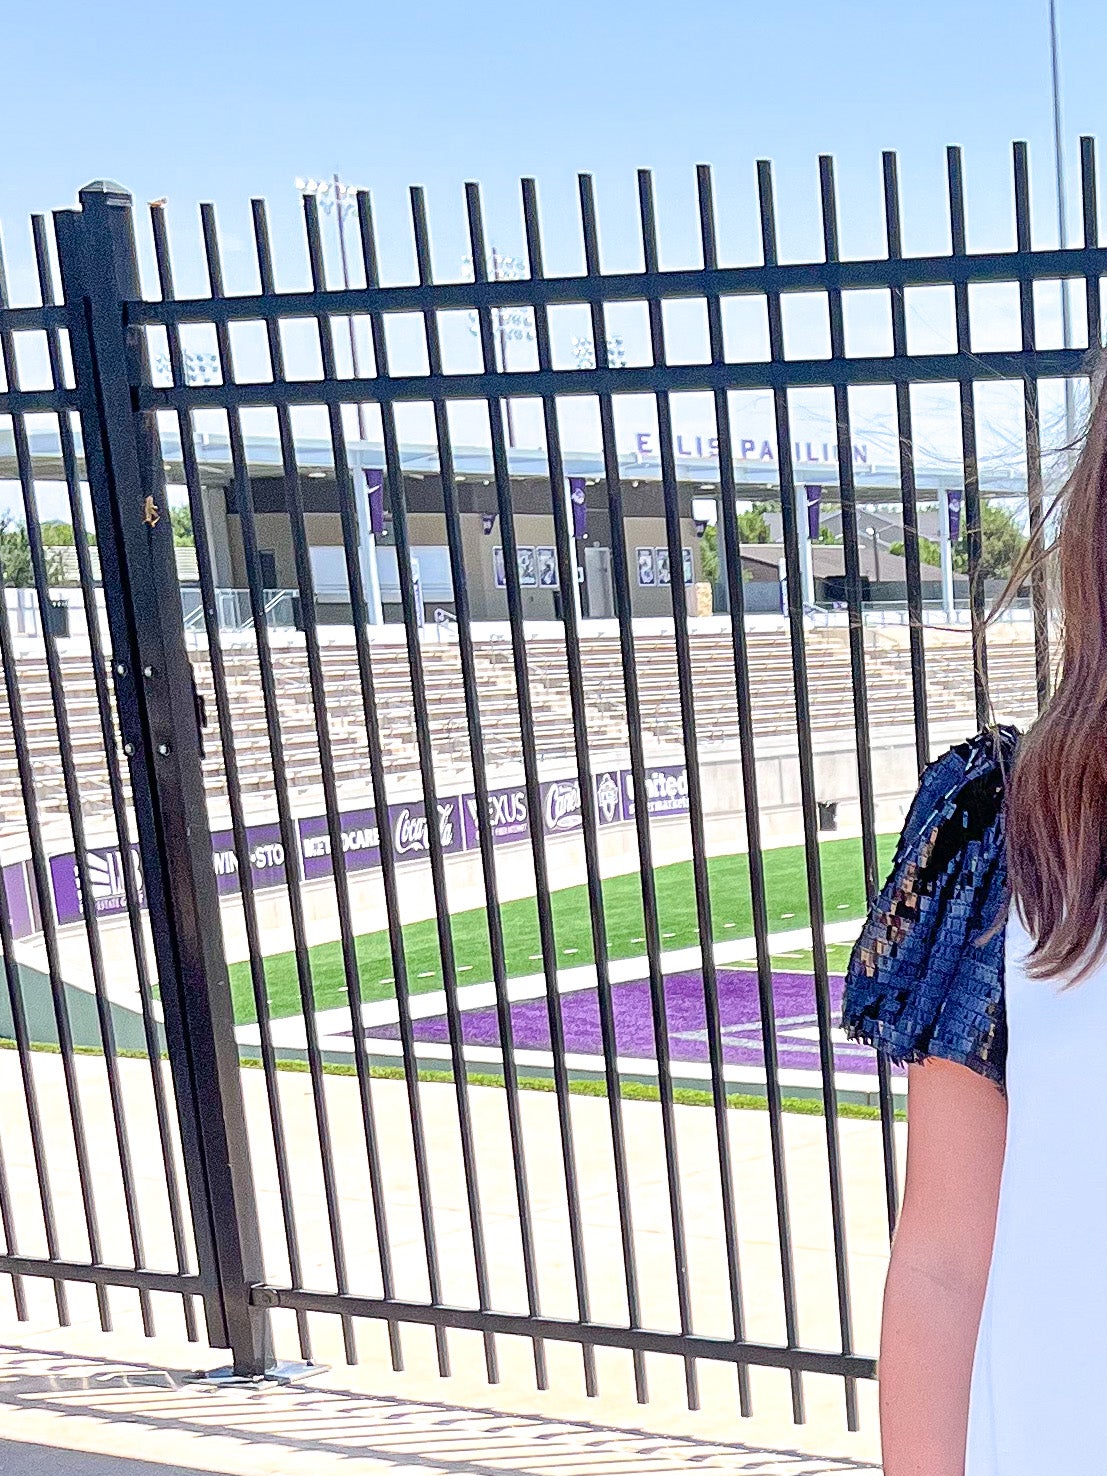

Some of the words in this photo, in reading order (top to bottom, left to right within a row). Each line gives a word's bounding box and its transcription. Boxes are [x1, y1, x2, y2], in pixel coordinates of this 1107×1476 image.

[636, 433, 719, 458] ELIS
[741, 439, 868, 463] PAILIN
[302, 827, 381, 859] METOCARE
